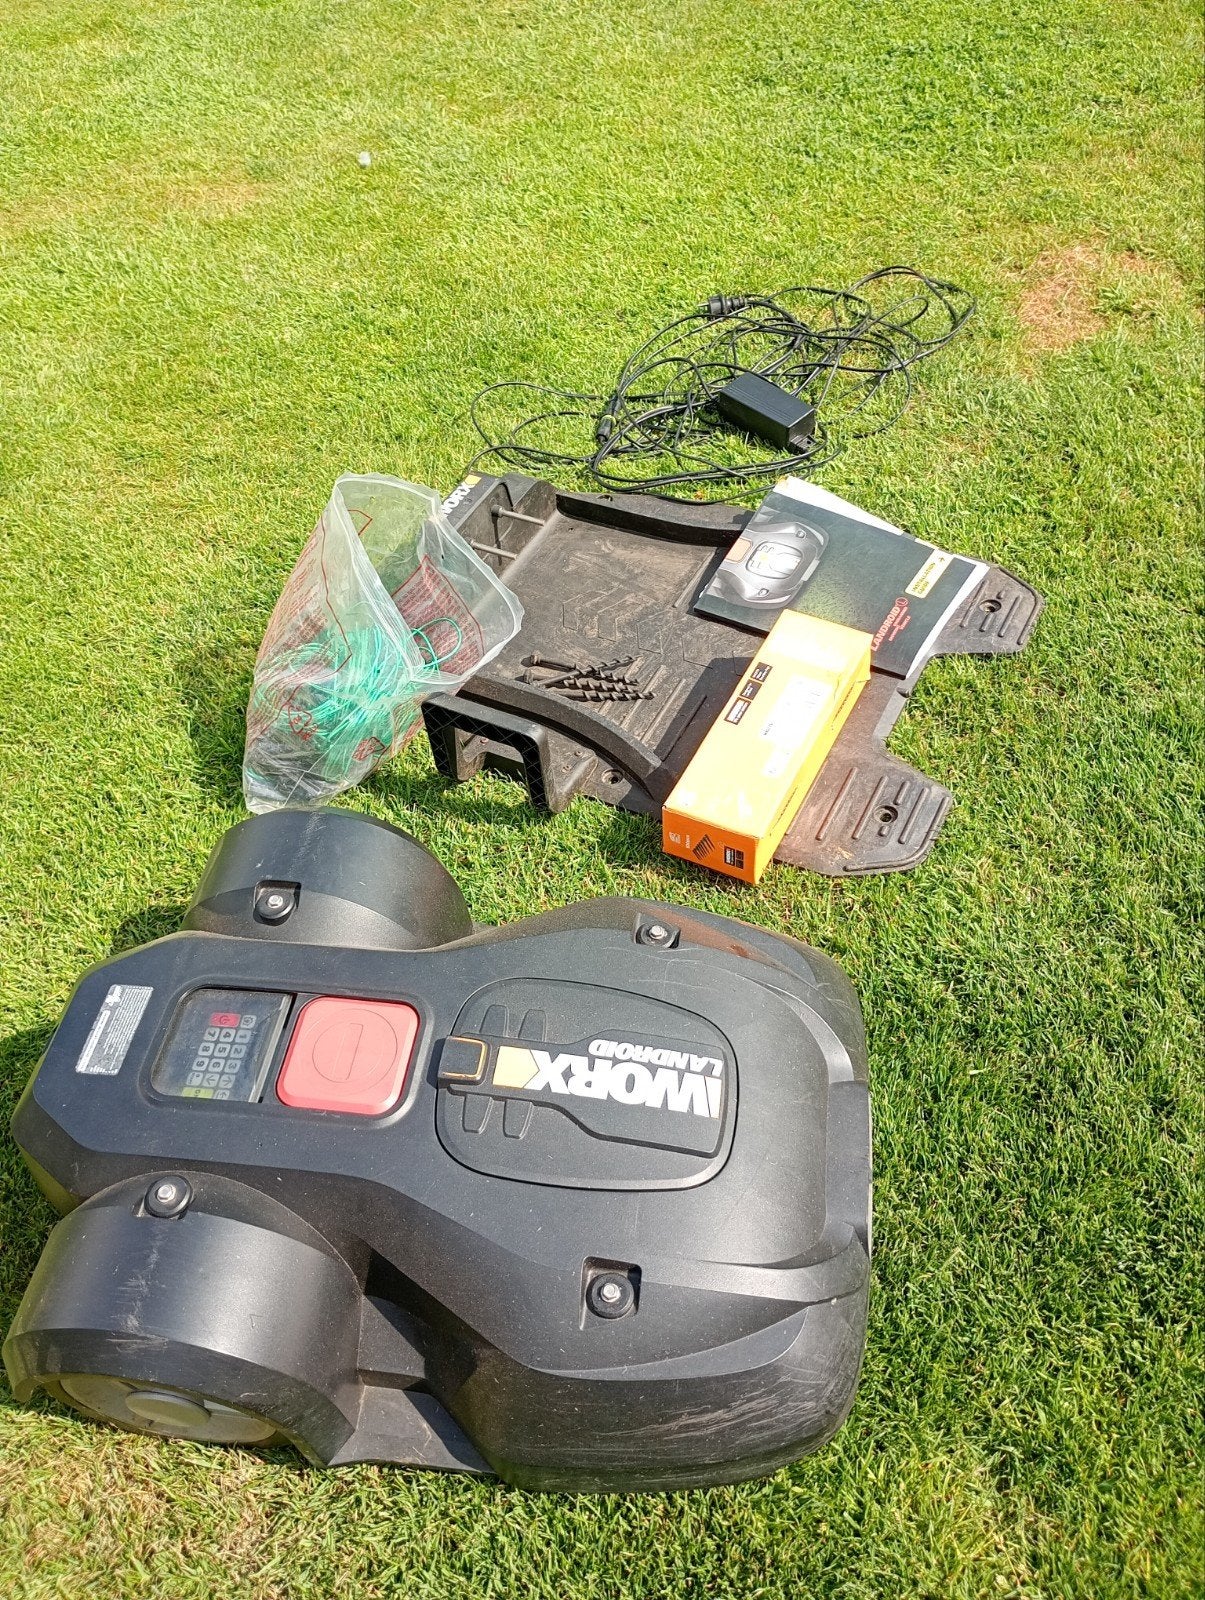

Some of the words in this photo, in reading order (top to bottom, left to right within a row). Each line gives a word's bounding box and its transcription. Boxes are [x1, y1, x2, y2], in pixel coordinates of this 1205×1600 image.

[870, 606, 901, 651] LANDROID
[207, 1030, 216, 1038] 7
[222, 1031, 231, 1039] 4
[202, 1045, 211, 1053] 8
[218, 1046, 226, 1054] 5
[588, 1039, 723, 1077] LANDROID
[196, 1060, 205, 1068] 9
[212, 1061, 221, 1069] 6
[228, 1062, 237, 1070] 3
[524, 1049, 722, 1119] WORX
